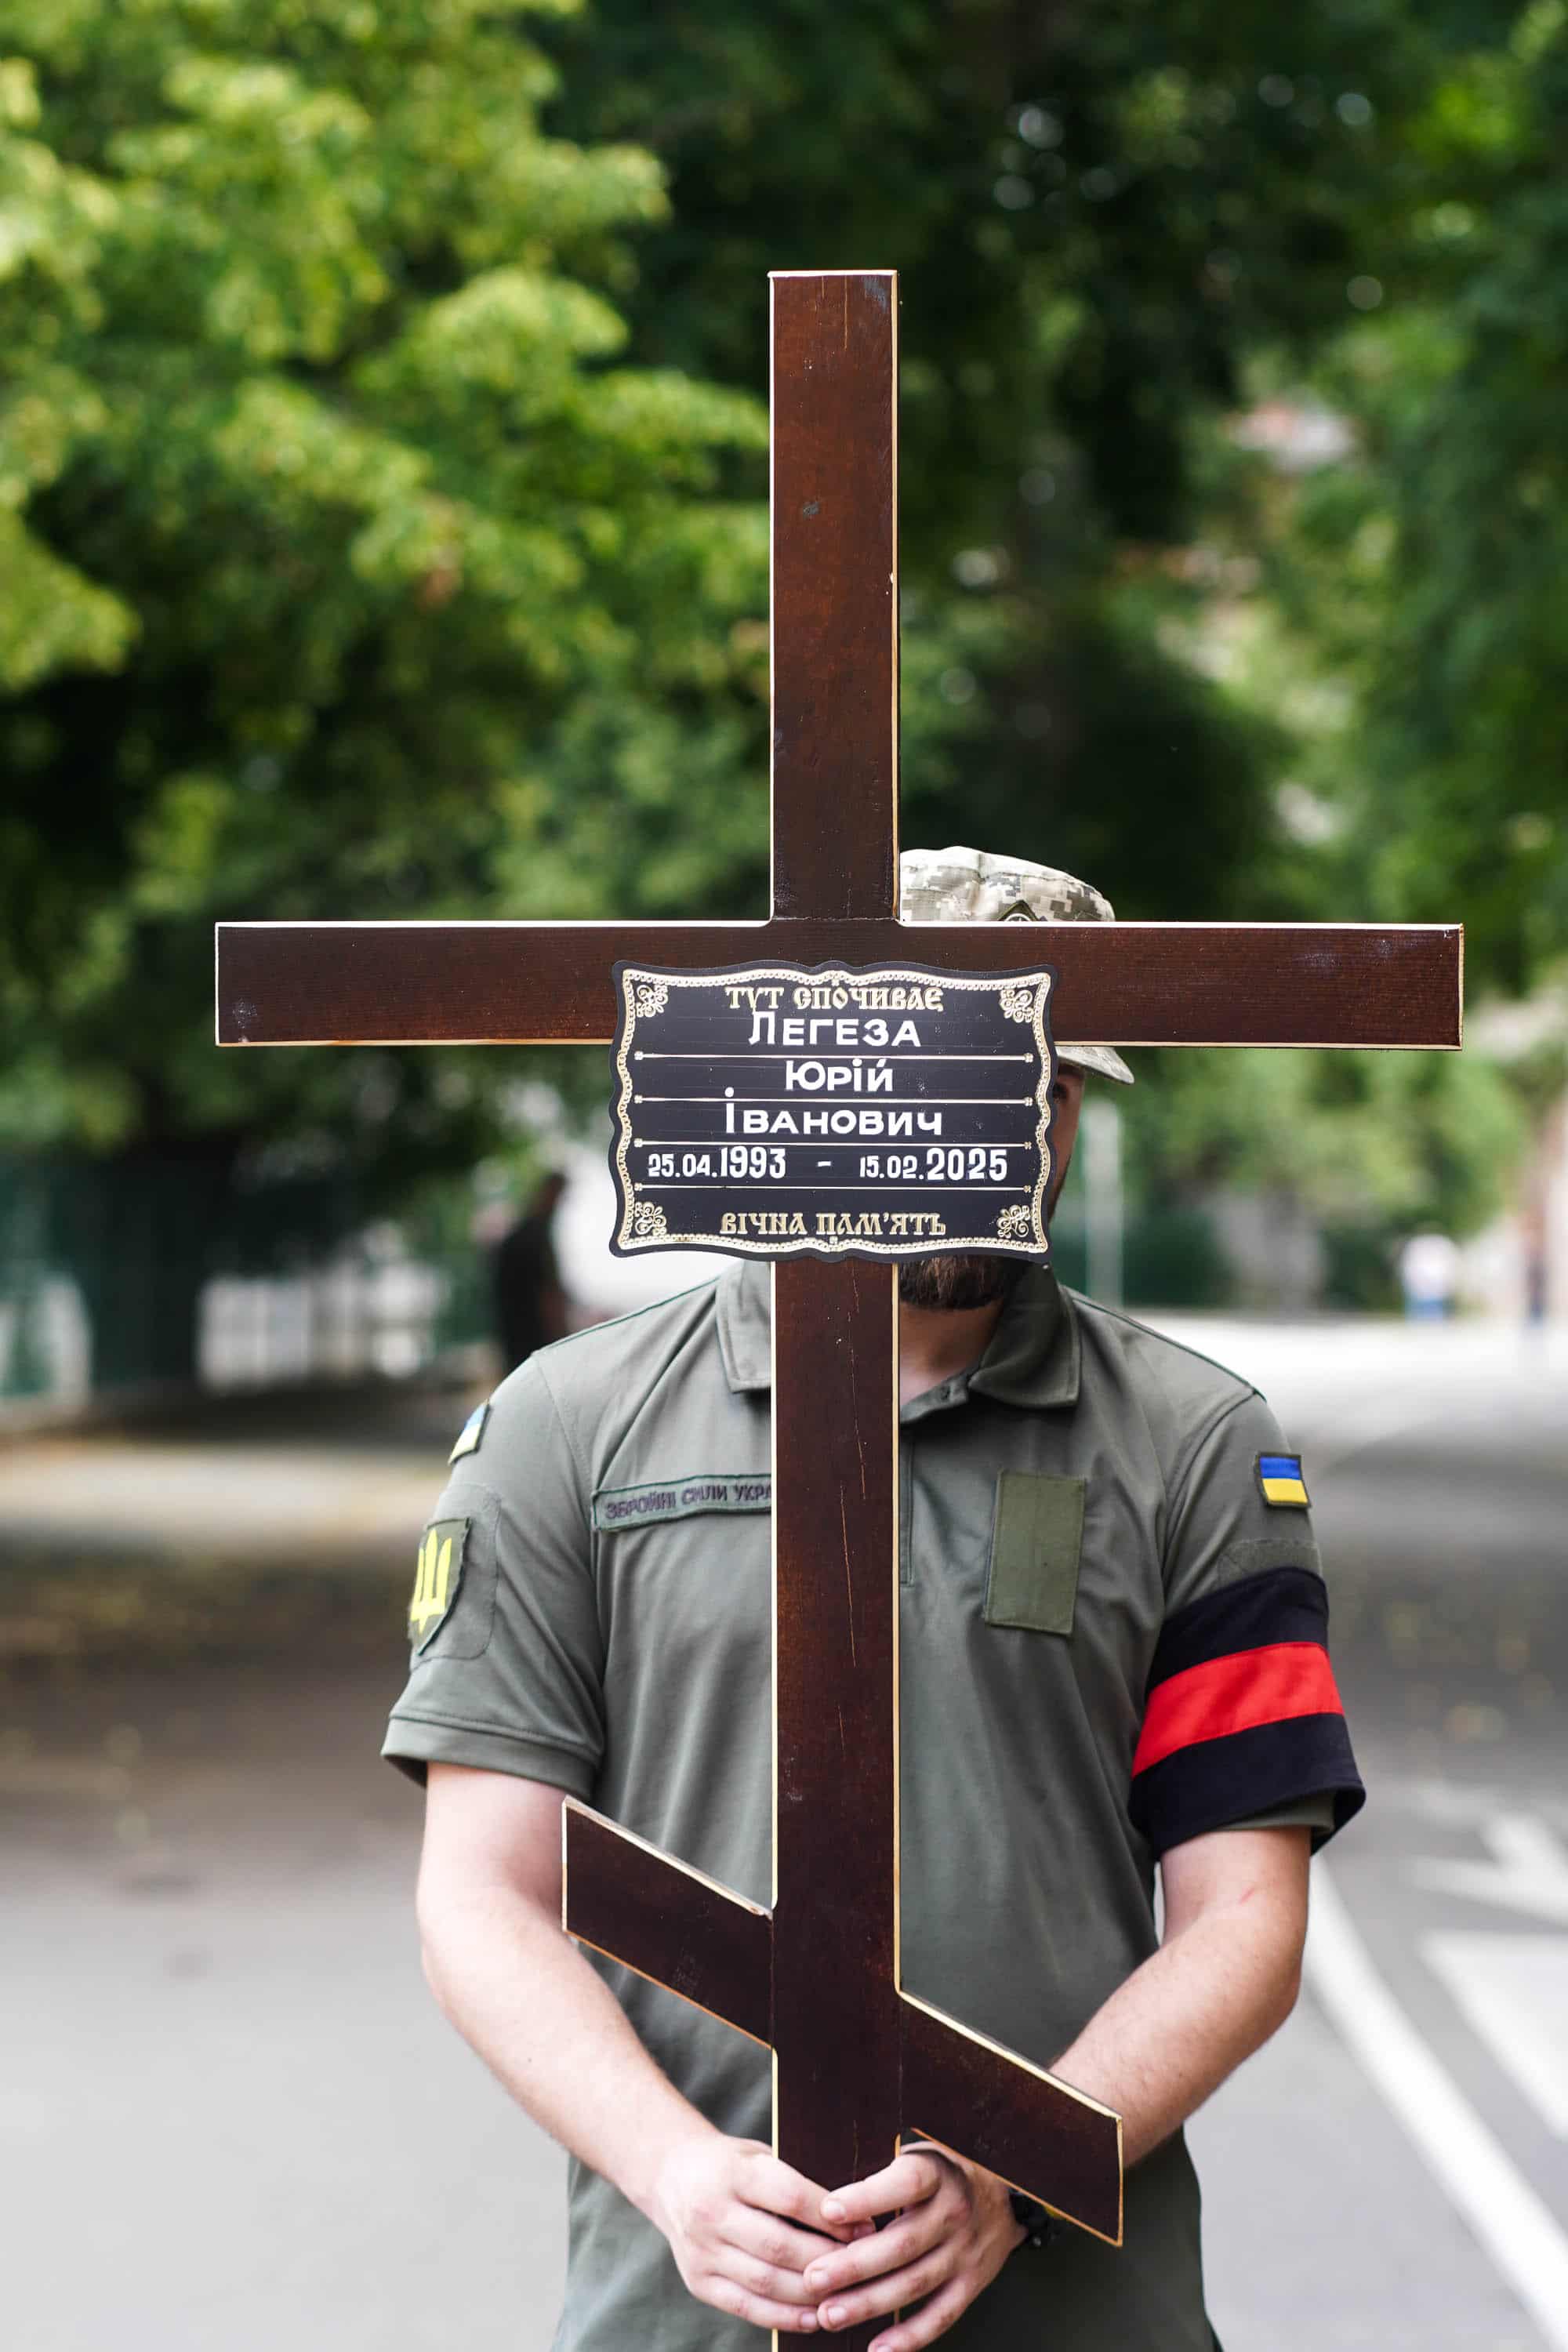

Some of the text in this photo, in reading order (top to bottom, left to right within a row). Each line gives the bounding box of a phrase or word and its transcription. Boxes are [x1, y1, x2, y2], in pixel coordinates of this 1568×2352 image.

[726, 986, 784, 1011] ТУТ
[648, 1145, 786, 1179] 25.04.1993
[859, 1148, 1008, 1181] 15.02.2025
[720, 1212, 804, 1236] ВІЧНА
[681, 1485, 728, 1505] СИЛИ
